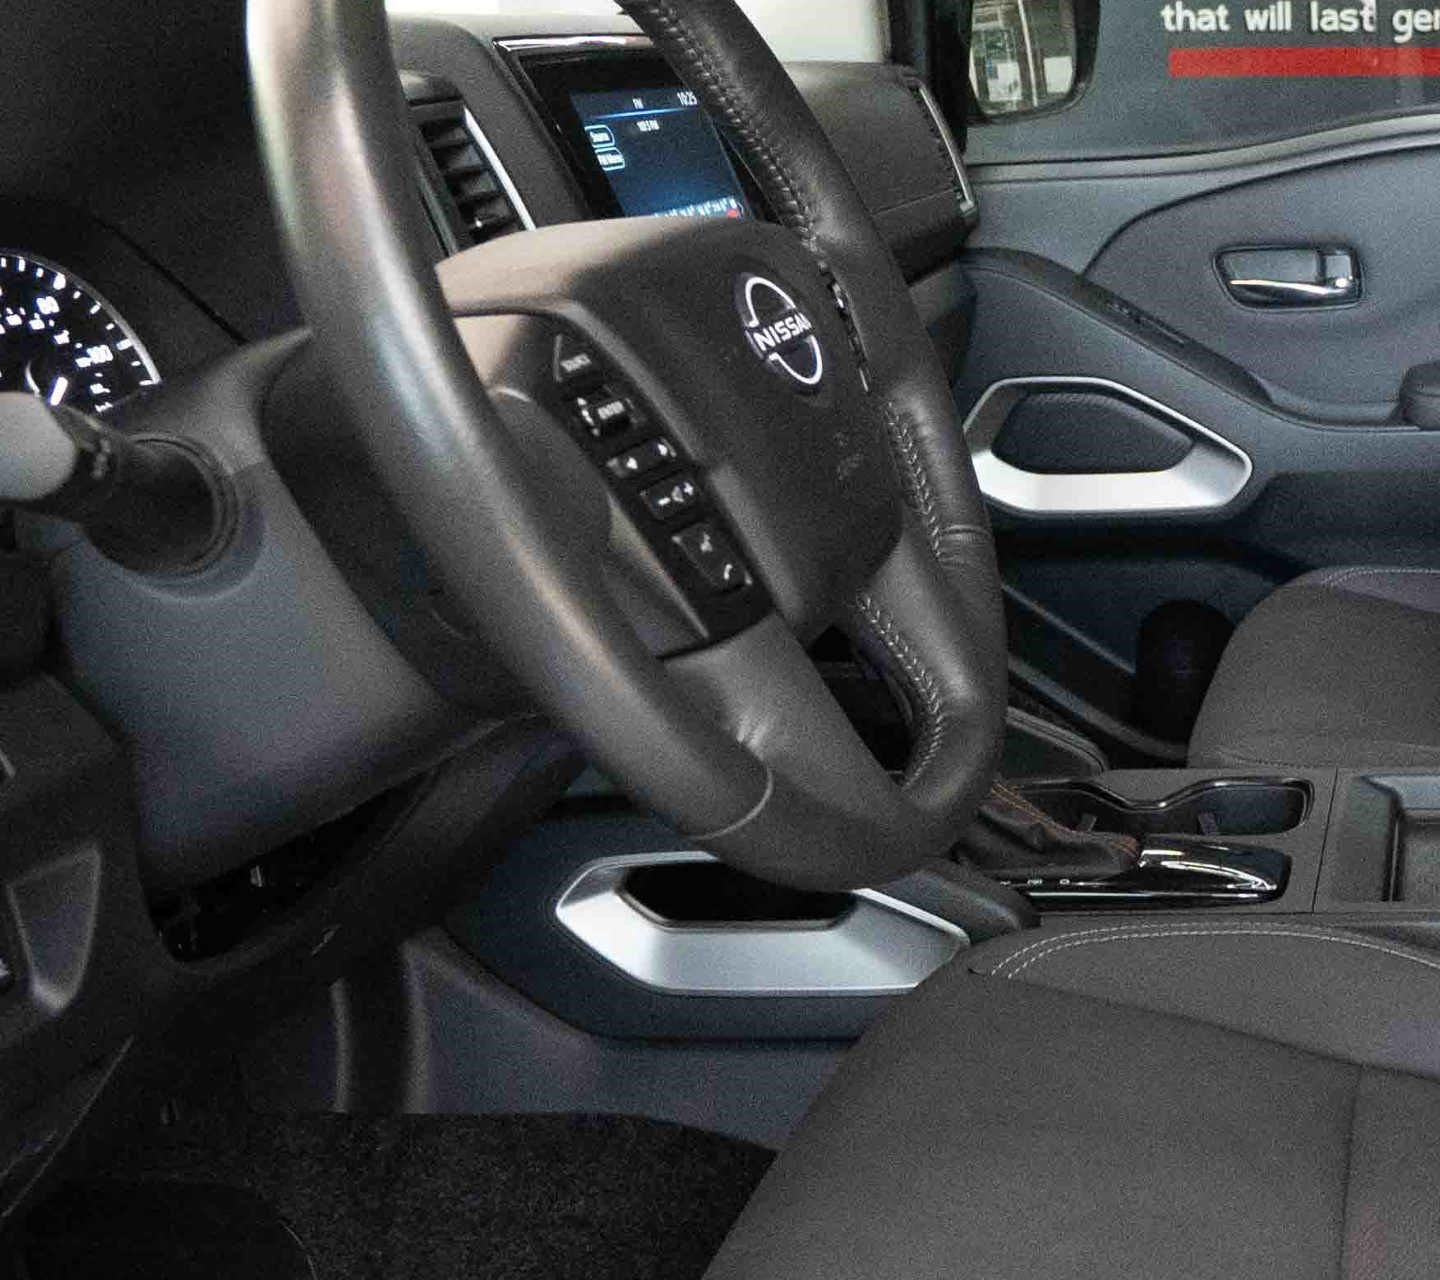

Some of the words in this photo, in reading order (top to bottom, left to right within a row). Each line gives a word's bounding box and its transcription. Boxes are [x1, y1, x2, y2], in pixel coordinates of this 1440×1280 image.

[1161, 0, 1229, 33] that
[1244, 1, 1293, 32] will
[1310, 0, 1377, 33] last
